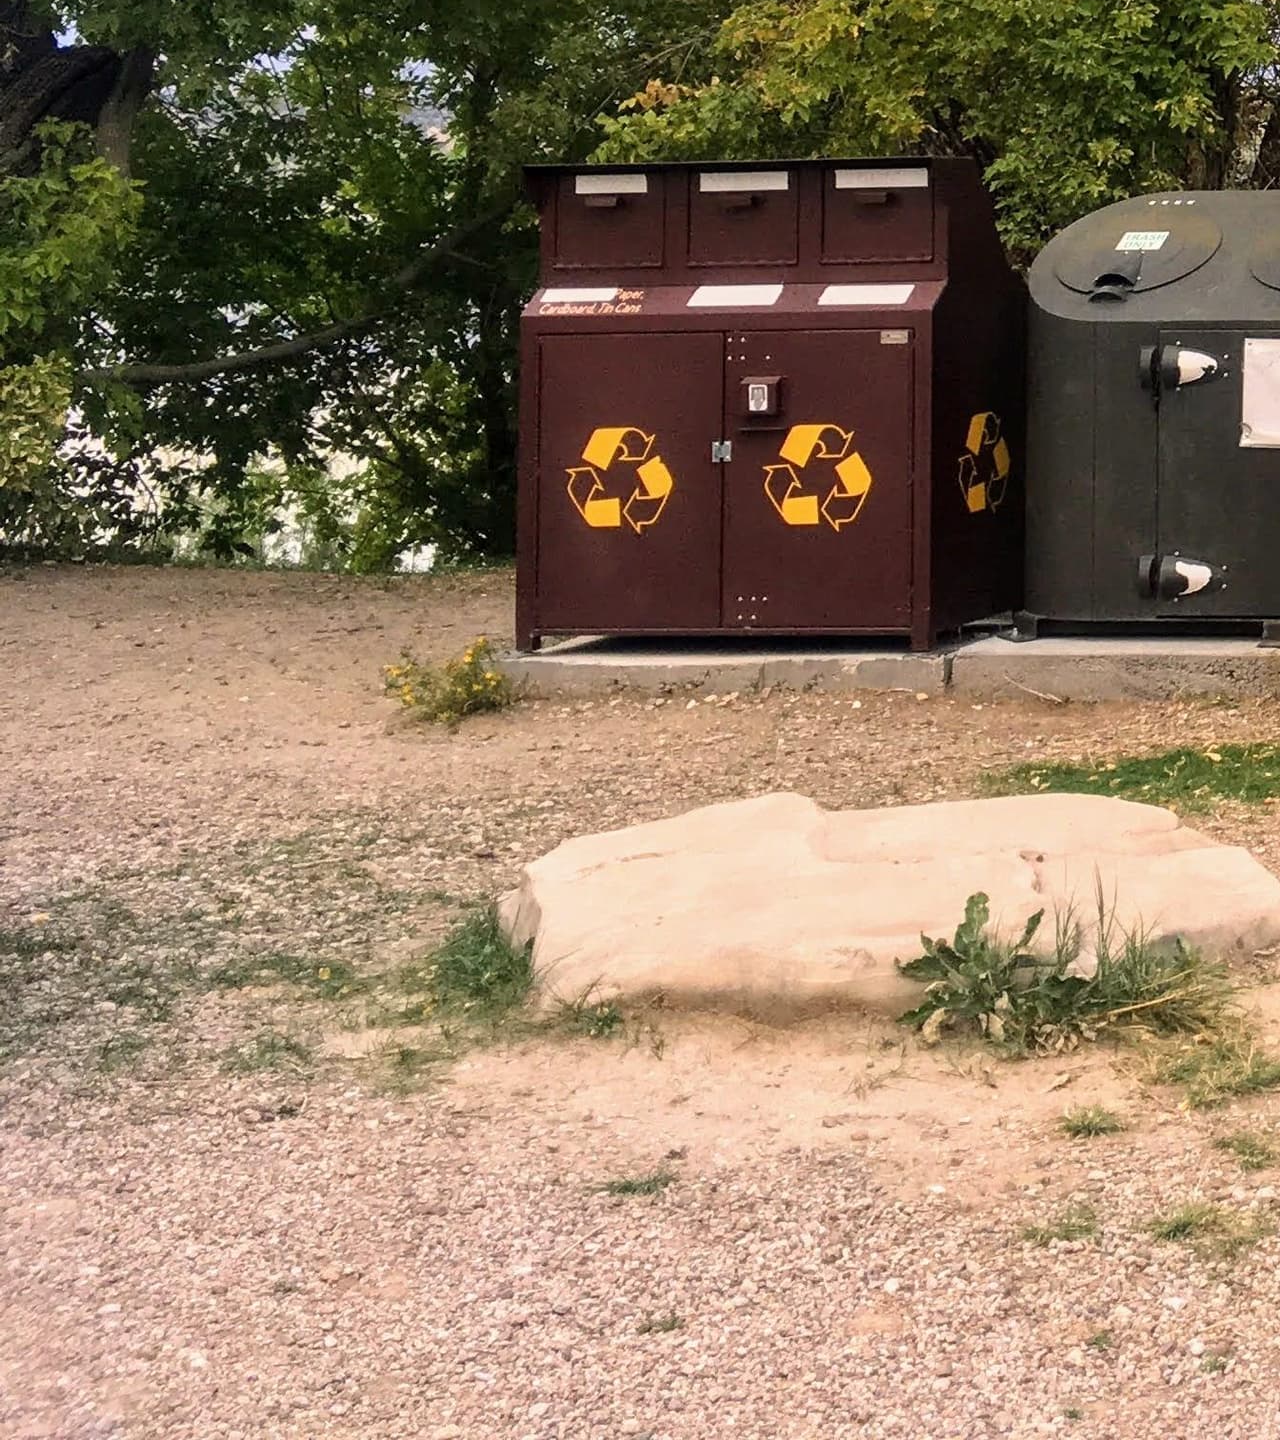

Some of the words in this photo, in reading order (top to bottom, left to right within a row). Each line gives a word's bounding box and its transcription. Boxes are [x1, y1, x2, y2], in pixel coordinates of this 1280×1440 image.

[1123, 240, 1154, 248] ONLY
[598, 302, 613, 314] Tin
[615, 302, 642, 314] Cans
